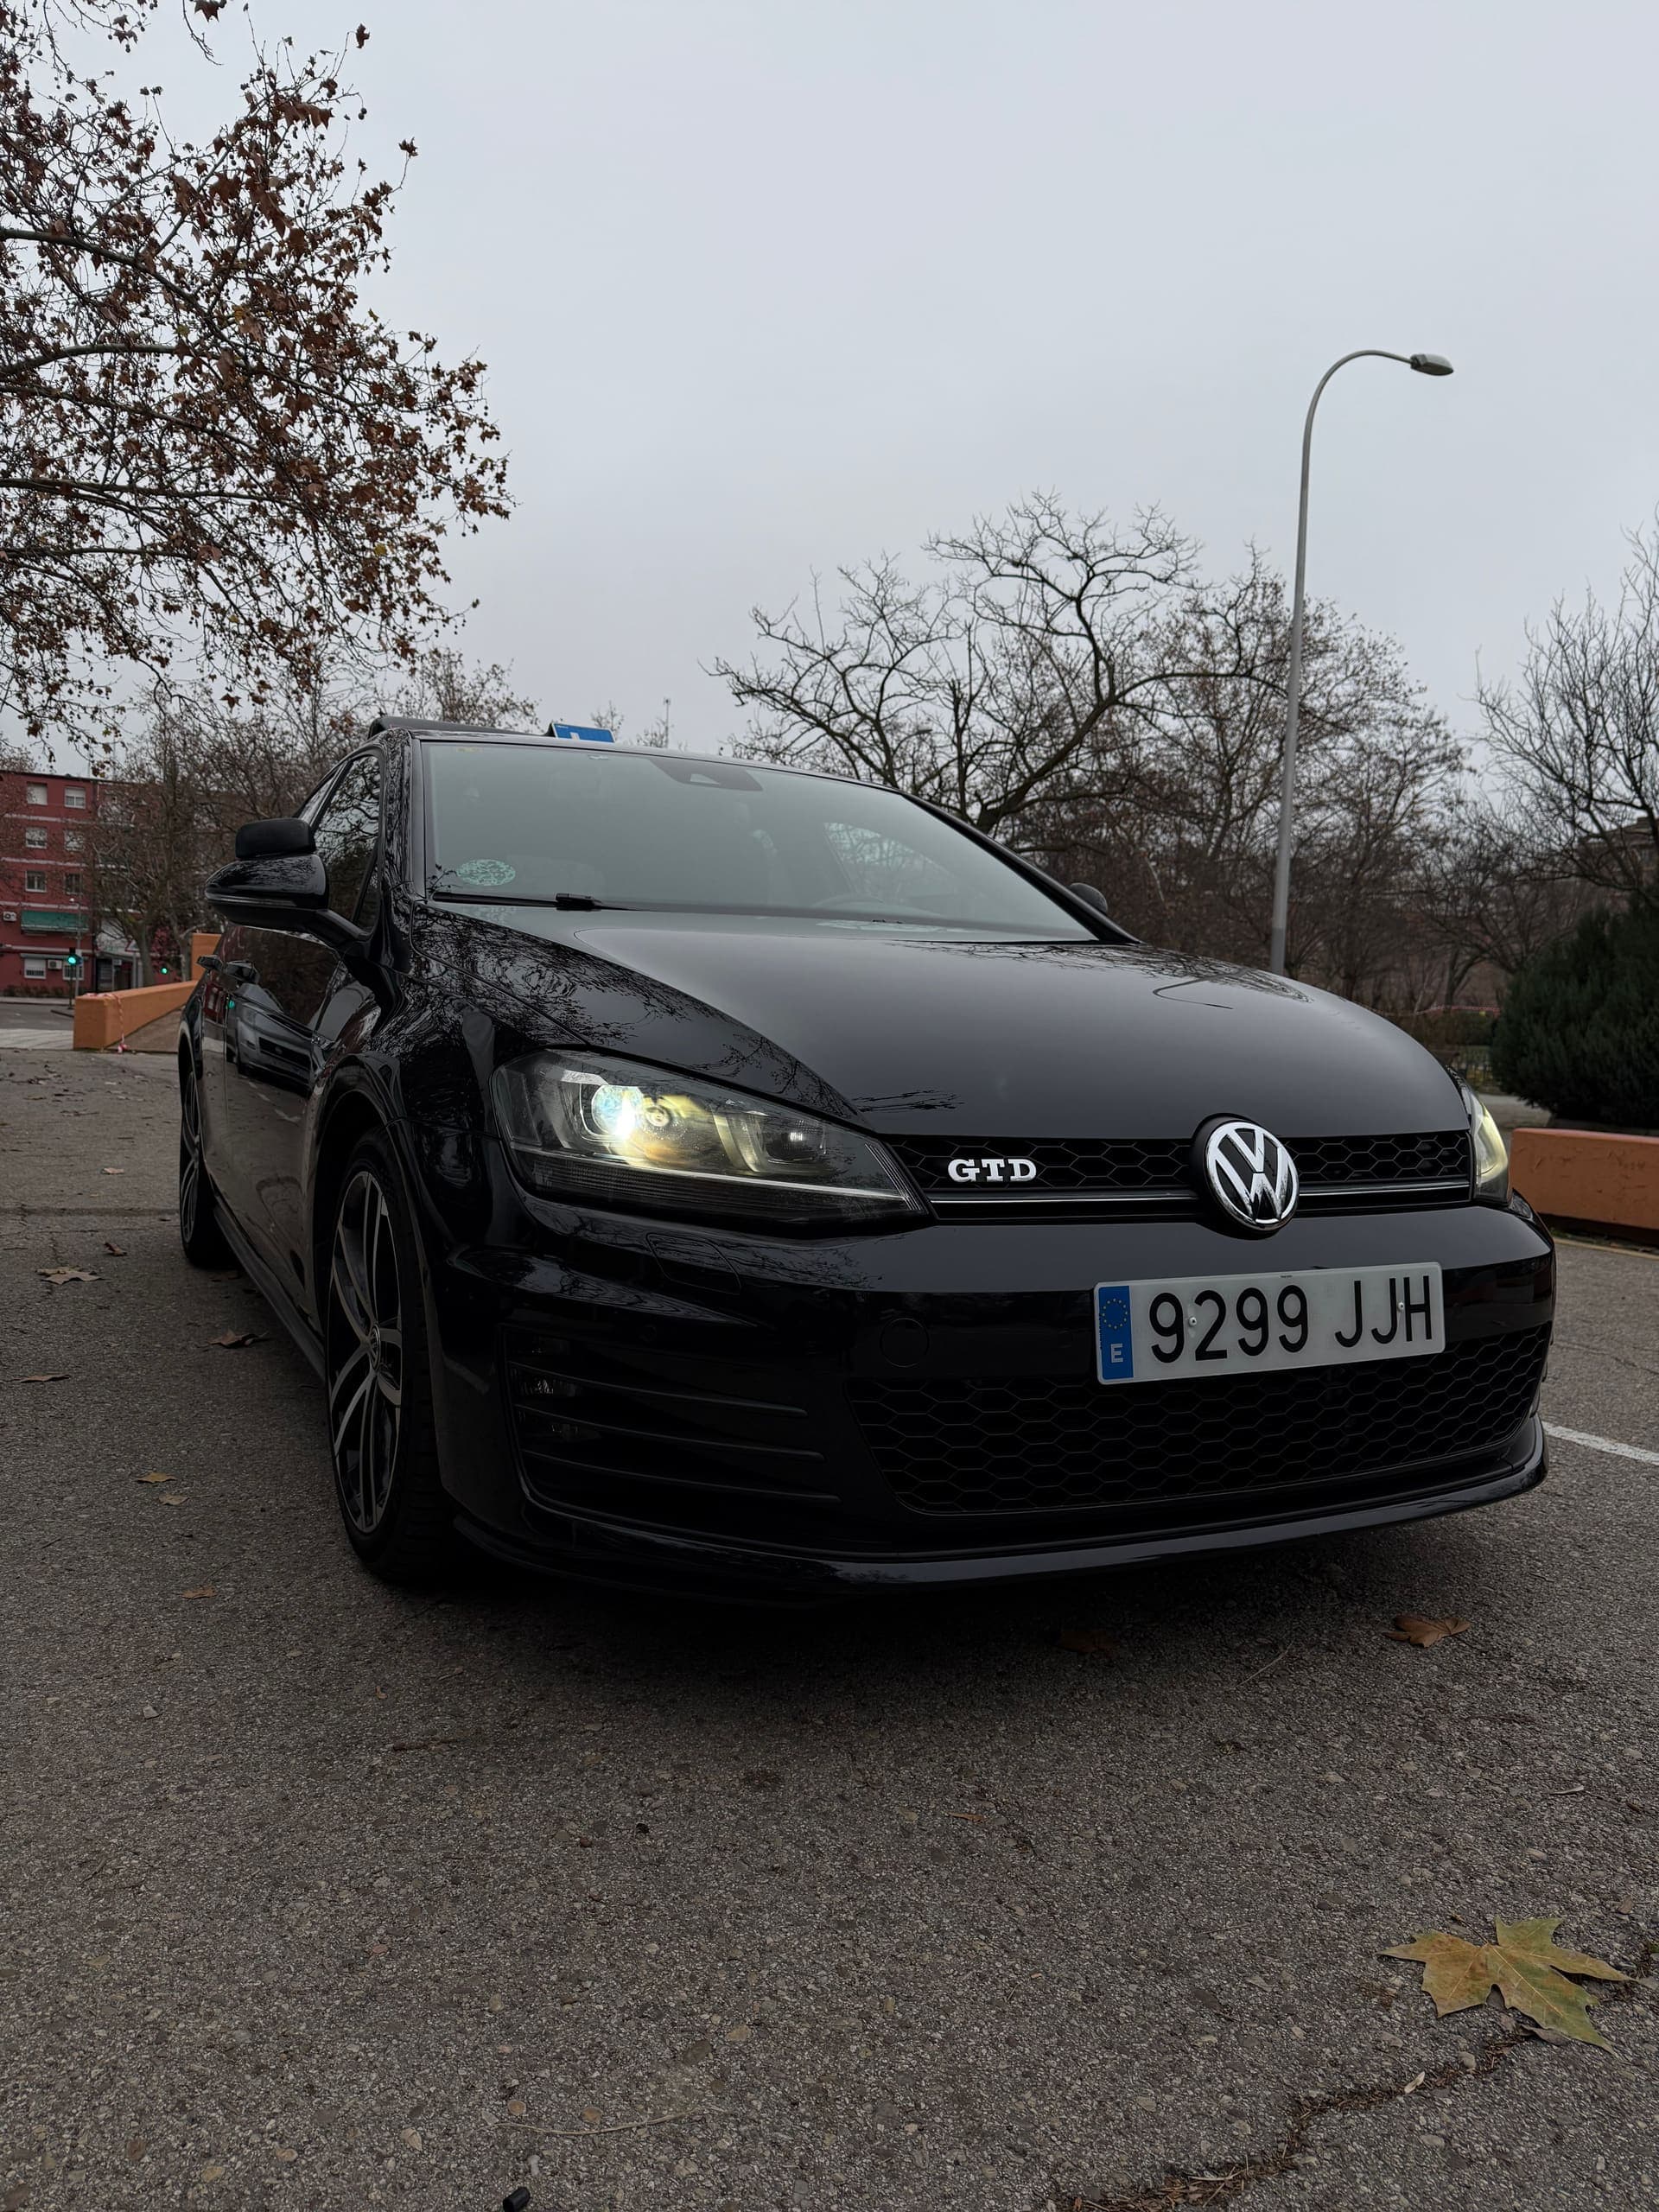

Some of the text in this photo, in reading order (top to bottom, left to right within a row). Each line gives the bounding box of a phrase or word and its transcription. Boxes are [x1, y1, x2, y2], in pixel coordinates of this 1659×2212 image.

[948, 1159, 1037, 1182] GTD
[1207, 1122, 1299, 1229] VW
[1149, 1284, 1308, 1363] 9299
[1335, 1275, 1432, 1348] JJH
[1110, 1343, 1123, 1363] E
